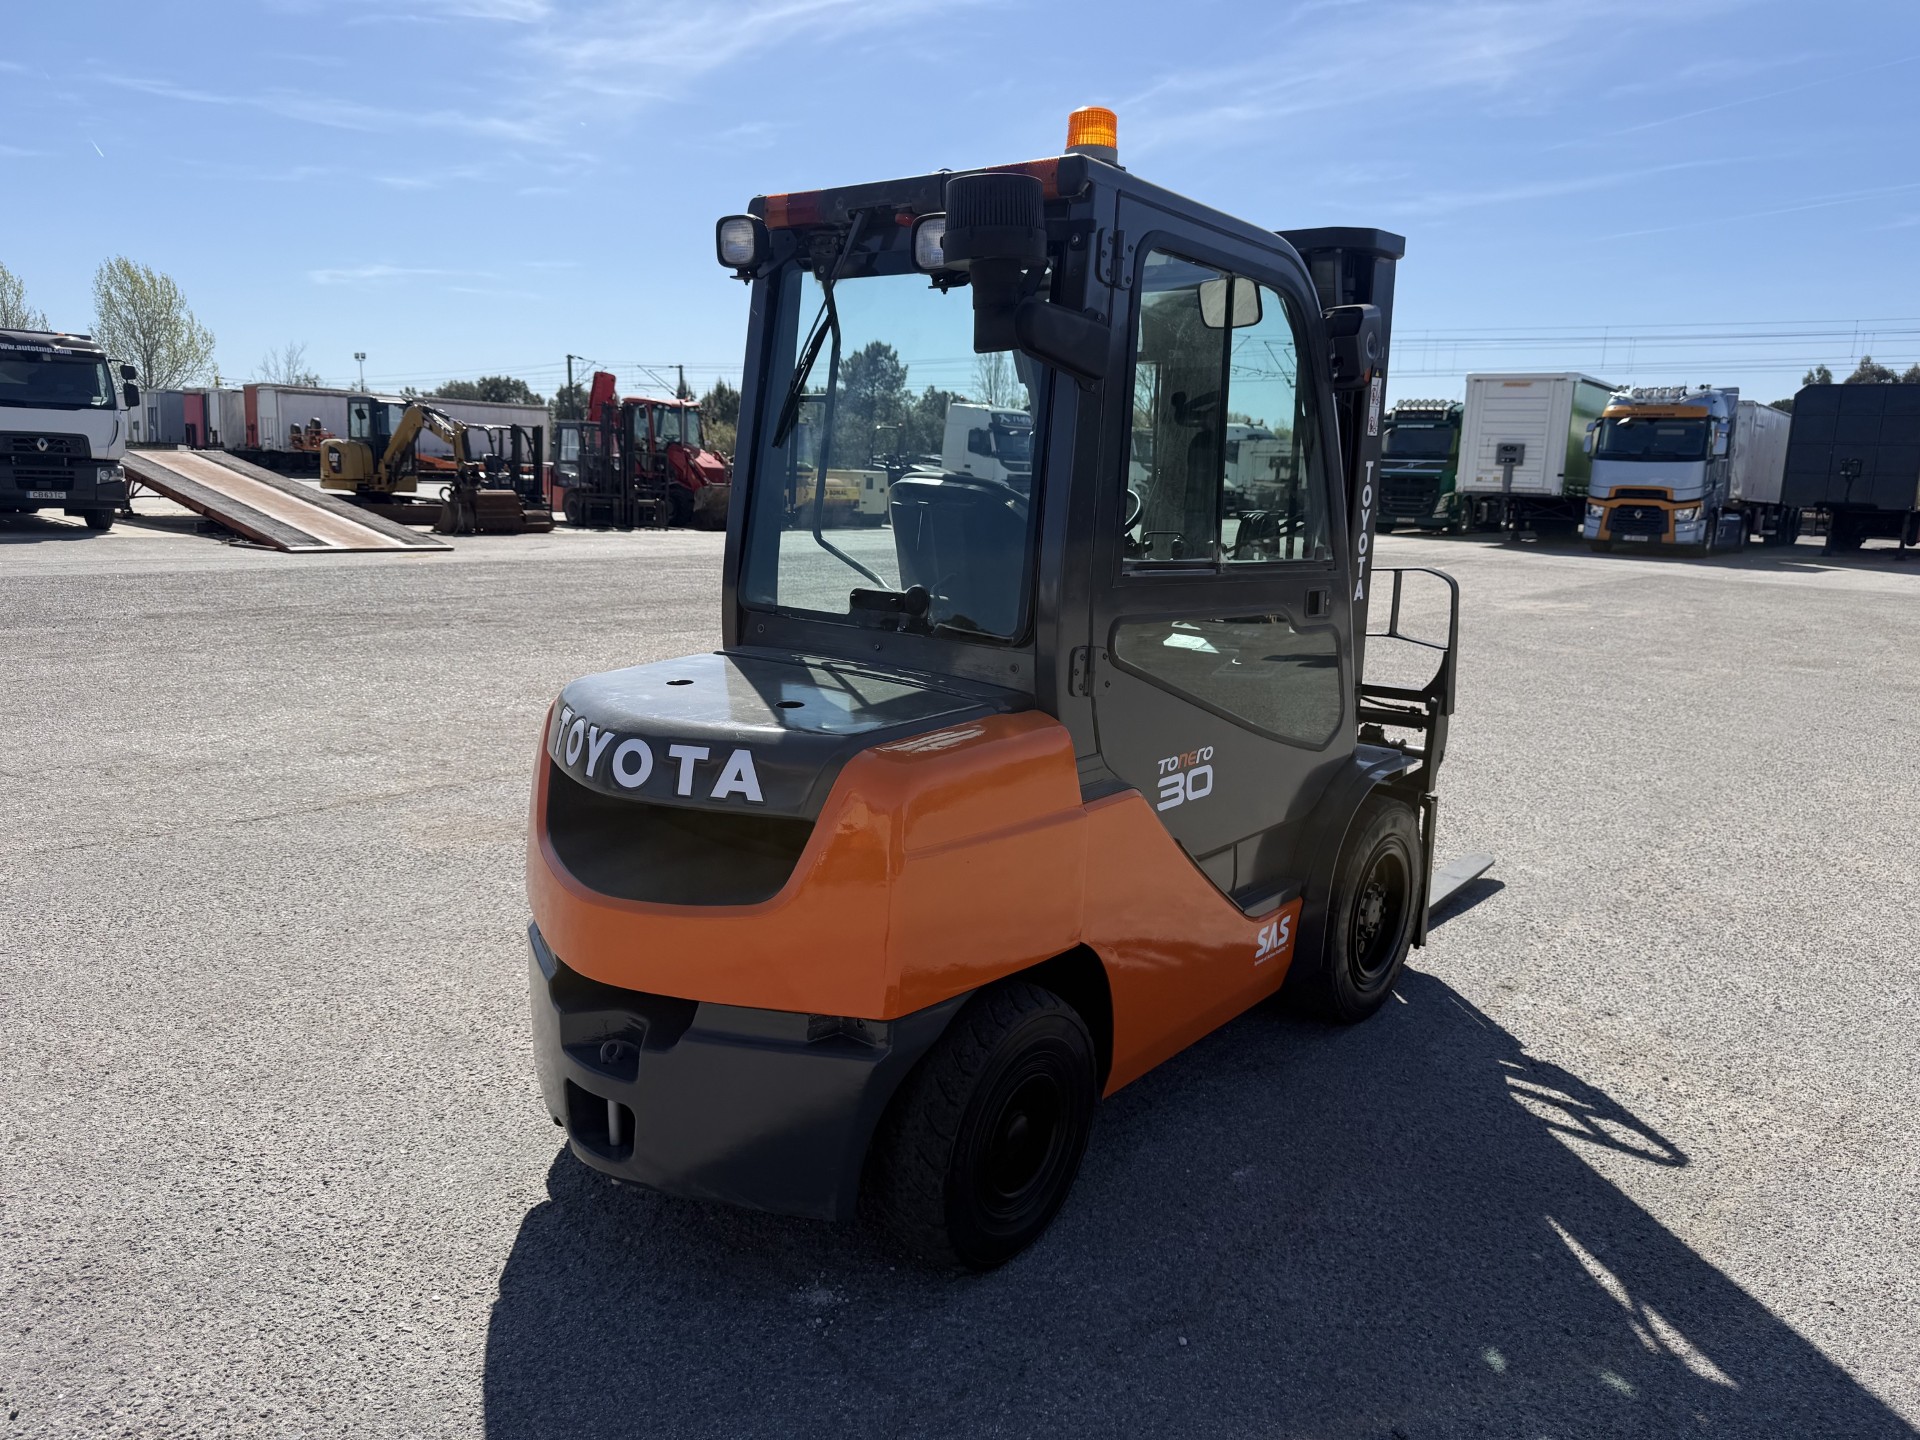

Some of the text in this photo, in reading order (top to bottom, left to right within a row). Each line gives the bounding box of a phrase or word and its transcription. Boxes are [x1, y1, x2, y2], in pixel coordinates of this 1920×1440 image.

[0, 342, 72, 355] ww.autotmp.com
[1353, 460, 1374, 601] TOYOTA
[554, 705, 764, 804] TOYOTA
[1156, 764, 1214, 812] 30
[1255, 914, 1291, 959] SAS
